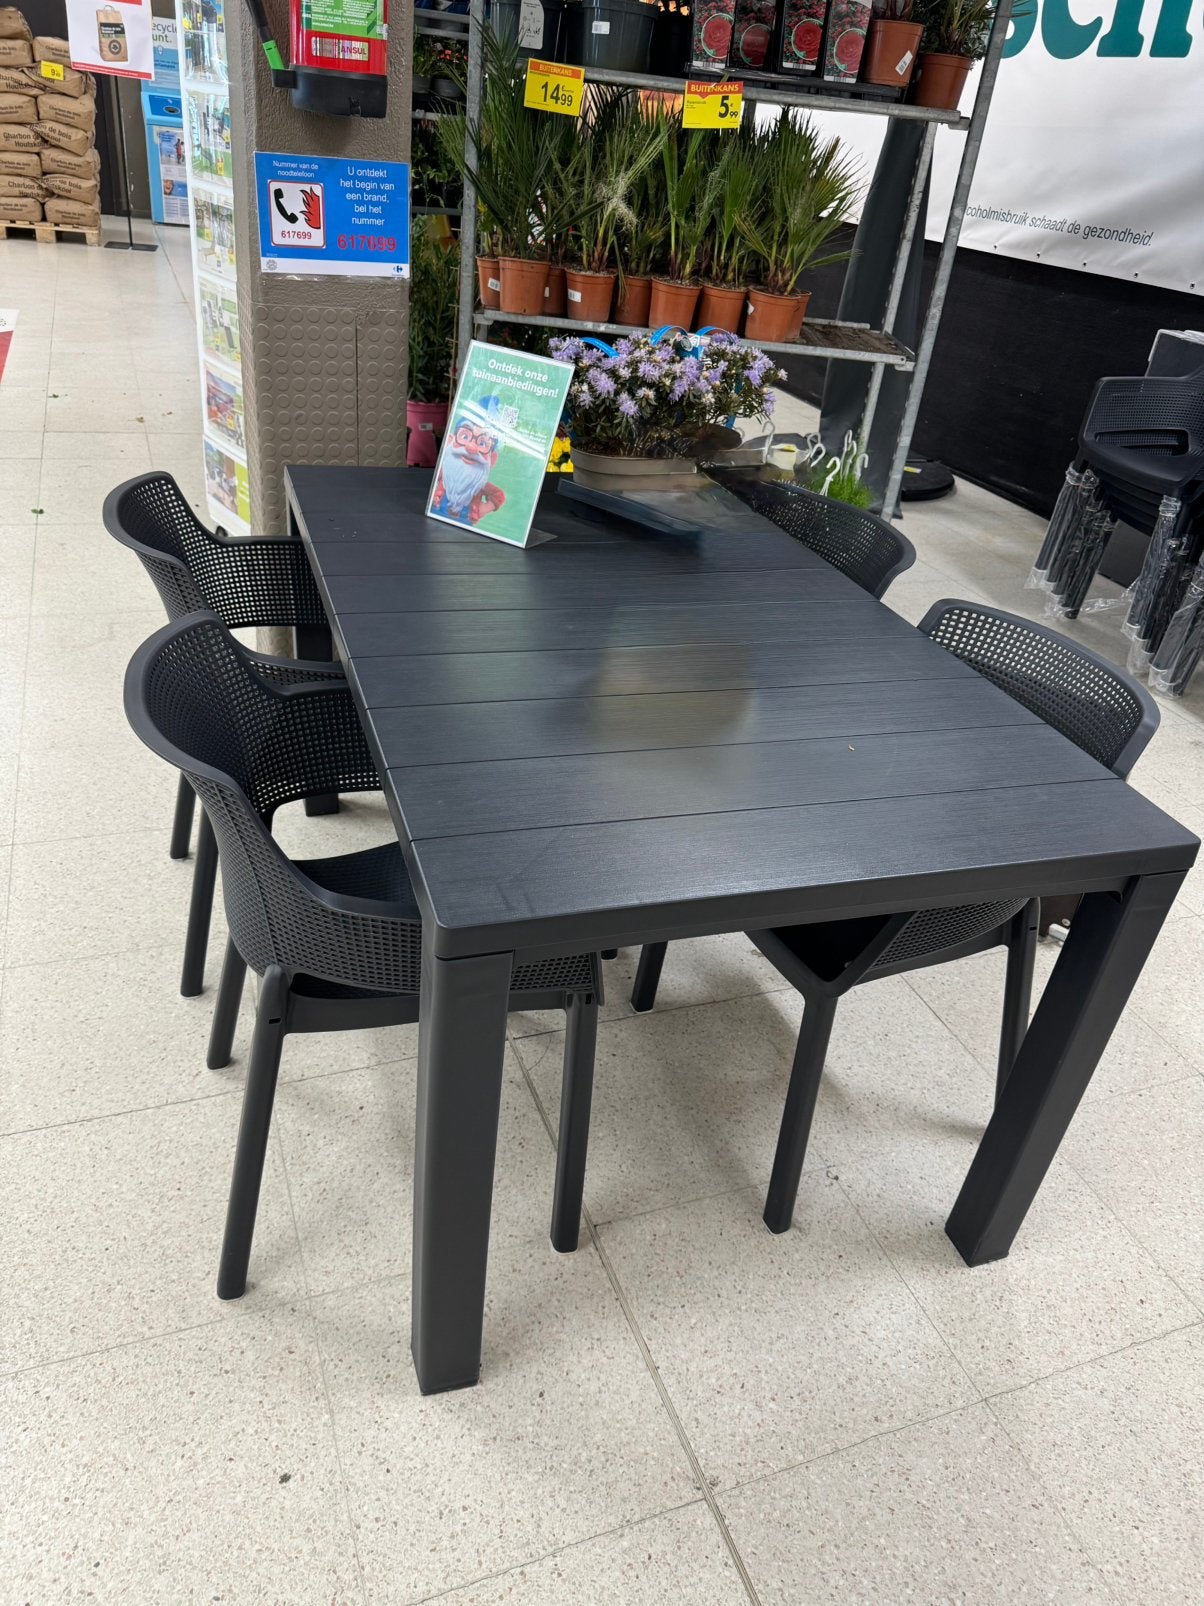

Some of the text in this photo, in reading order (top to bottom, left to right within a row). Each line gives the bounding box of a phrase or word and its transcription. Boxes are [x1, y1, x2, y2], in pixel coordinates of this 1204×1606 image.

[341, 46, 367, 55] ANSUL
[541, 81, 560, 104] 14
[691, 84, 739, 92] BUITENKANS
[718, 95, 730, 119] 5
[272, 160, 298, 168] Nummer
[277, 169, 315, 178] noodtelefoon
[347, 167, 387, 178] U ontdekt
[340, 178, 395, 191] het begin van
[363, 192, 390, 203] brand,
[354, 203, 382, 214] bel het
[351, 217, 385, 226] nummer
[966, 205, 1154, 247] coholmisbruik schaadt de gezondheid.
[281, 230, 312, 240] 617699
[337, 234, 396, 252] 617699
[488, 359, 549, 382] Ontdek onze
[472, 367, 559, 398] tuinaanbiedingen!
